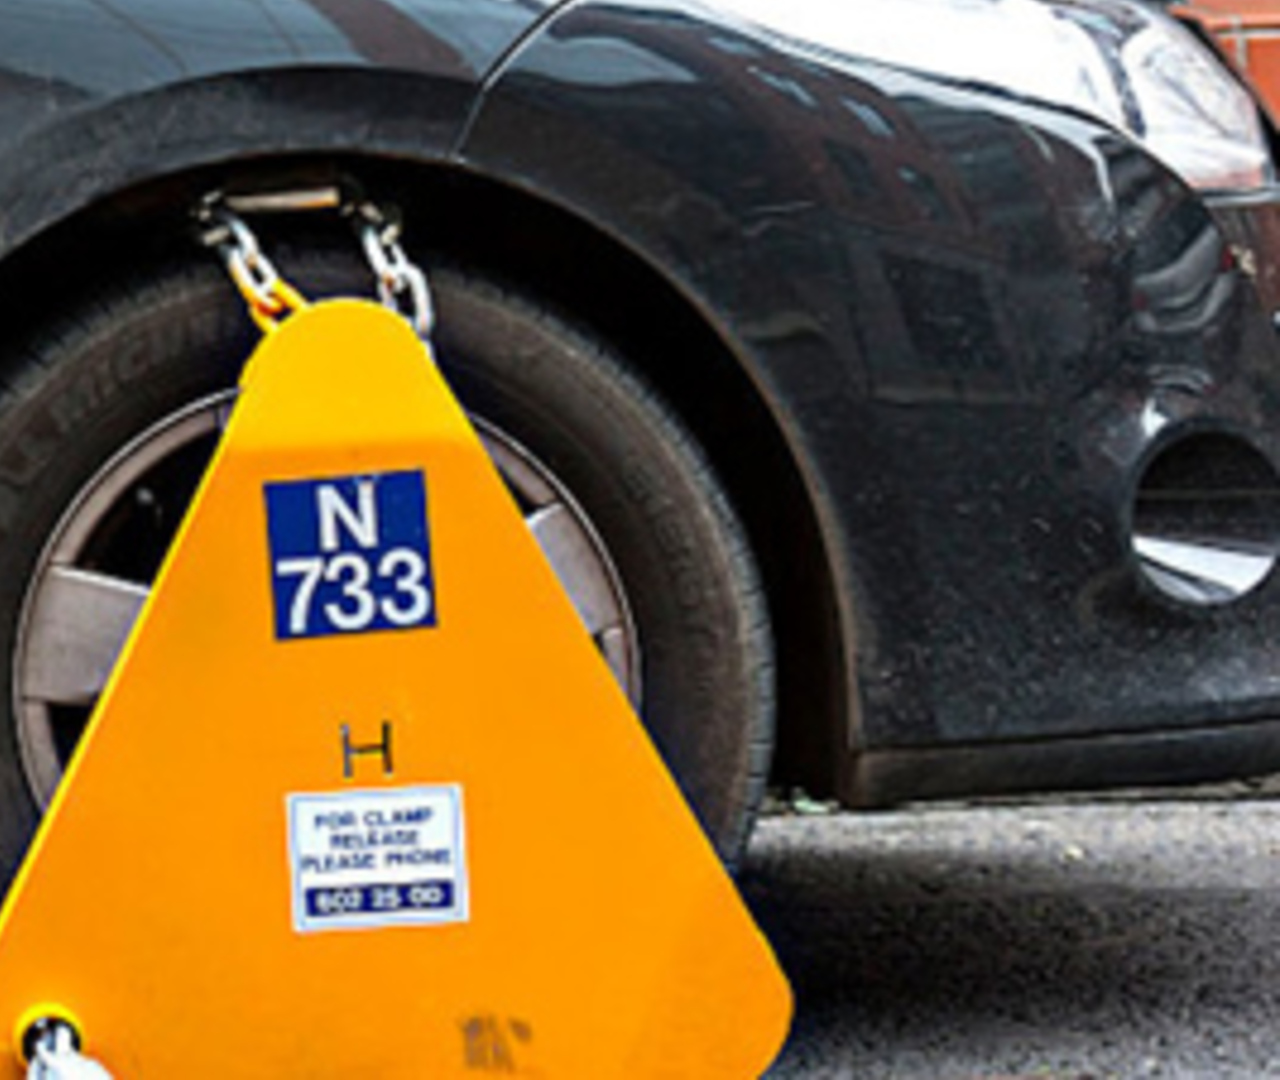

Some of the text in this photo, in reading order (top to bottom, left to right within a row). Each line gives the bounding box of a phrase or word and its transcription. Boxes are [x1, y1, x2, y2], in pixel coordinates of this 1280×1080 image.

[316, 481, 378, 551] N
[276, 547, 431, 634] 733
[341, 721, 393, 778] H
[314, 806, 433, 829] FOR CLAMP
[329, 829, 419, 849] RELEASE
[301, 848, 451, 873] PLEASE PHONE
